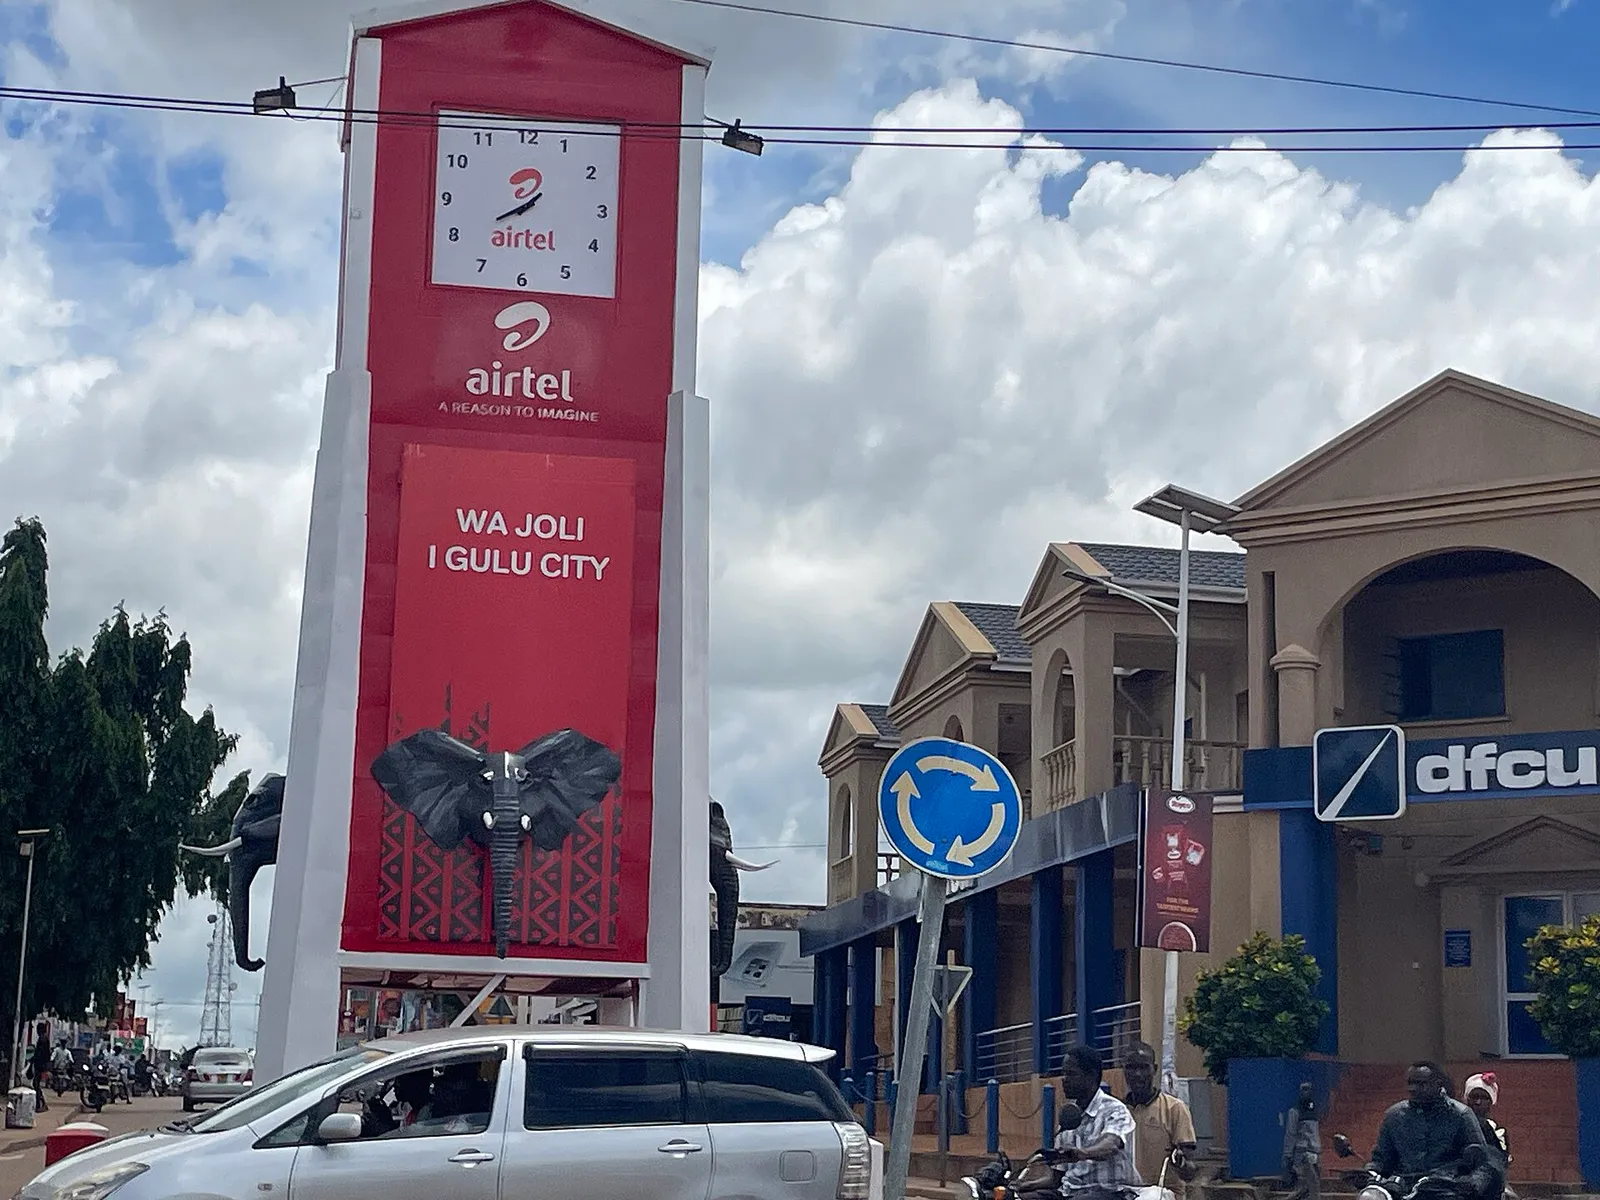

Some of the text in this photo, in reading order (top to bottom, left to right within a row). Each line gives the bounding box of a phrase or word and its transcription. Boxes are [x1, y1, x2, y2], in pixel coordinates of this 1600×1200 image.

[473, 131, 492, 146] 11
[517, 130, 539, 145] 12
[560, 139, 568, 153] 1
[447, 154, 468, 169] 10
[585, 165, 597, 180] 2
[441, 191, 452, 206] 9
[596, 204, 608, 219] 3
[448, 227, 459, 242] 8
[491, 226, 556, 252] airtel
[587, 239, 599, 253] 4
[476, 258, 487, 272] 7
[560, 265, 571, 279] 5
[516, 272, 528, 287] 6
[465, 361, 574, 402] airtel
[438, 401, 600, 422] A REASON TO IMAGINE
[456, 508, 584, 541] WA JOLI
[428, 544, 610, 581] I GULU CITY
[1416, 742, 1598, 794] dfcu
